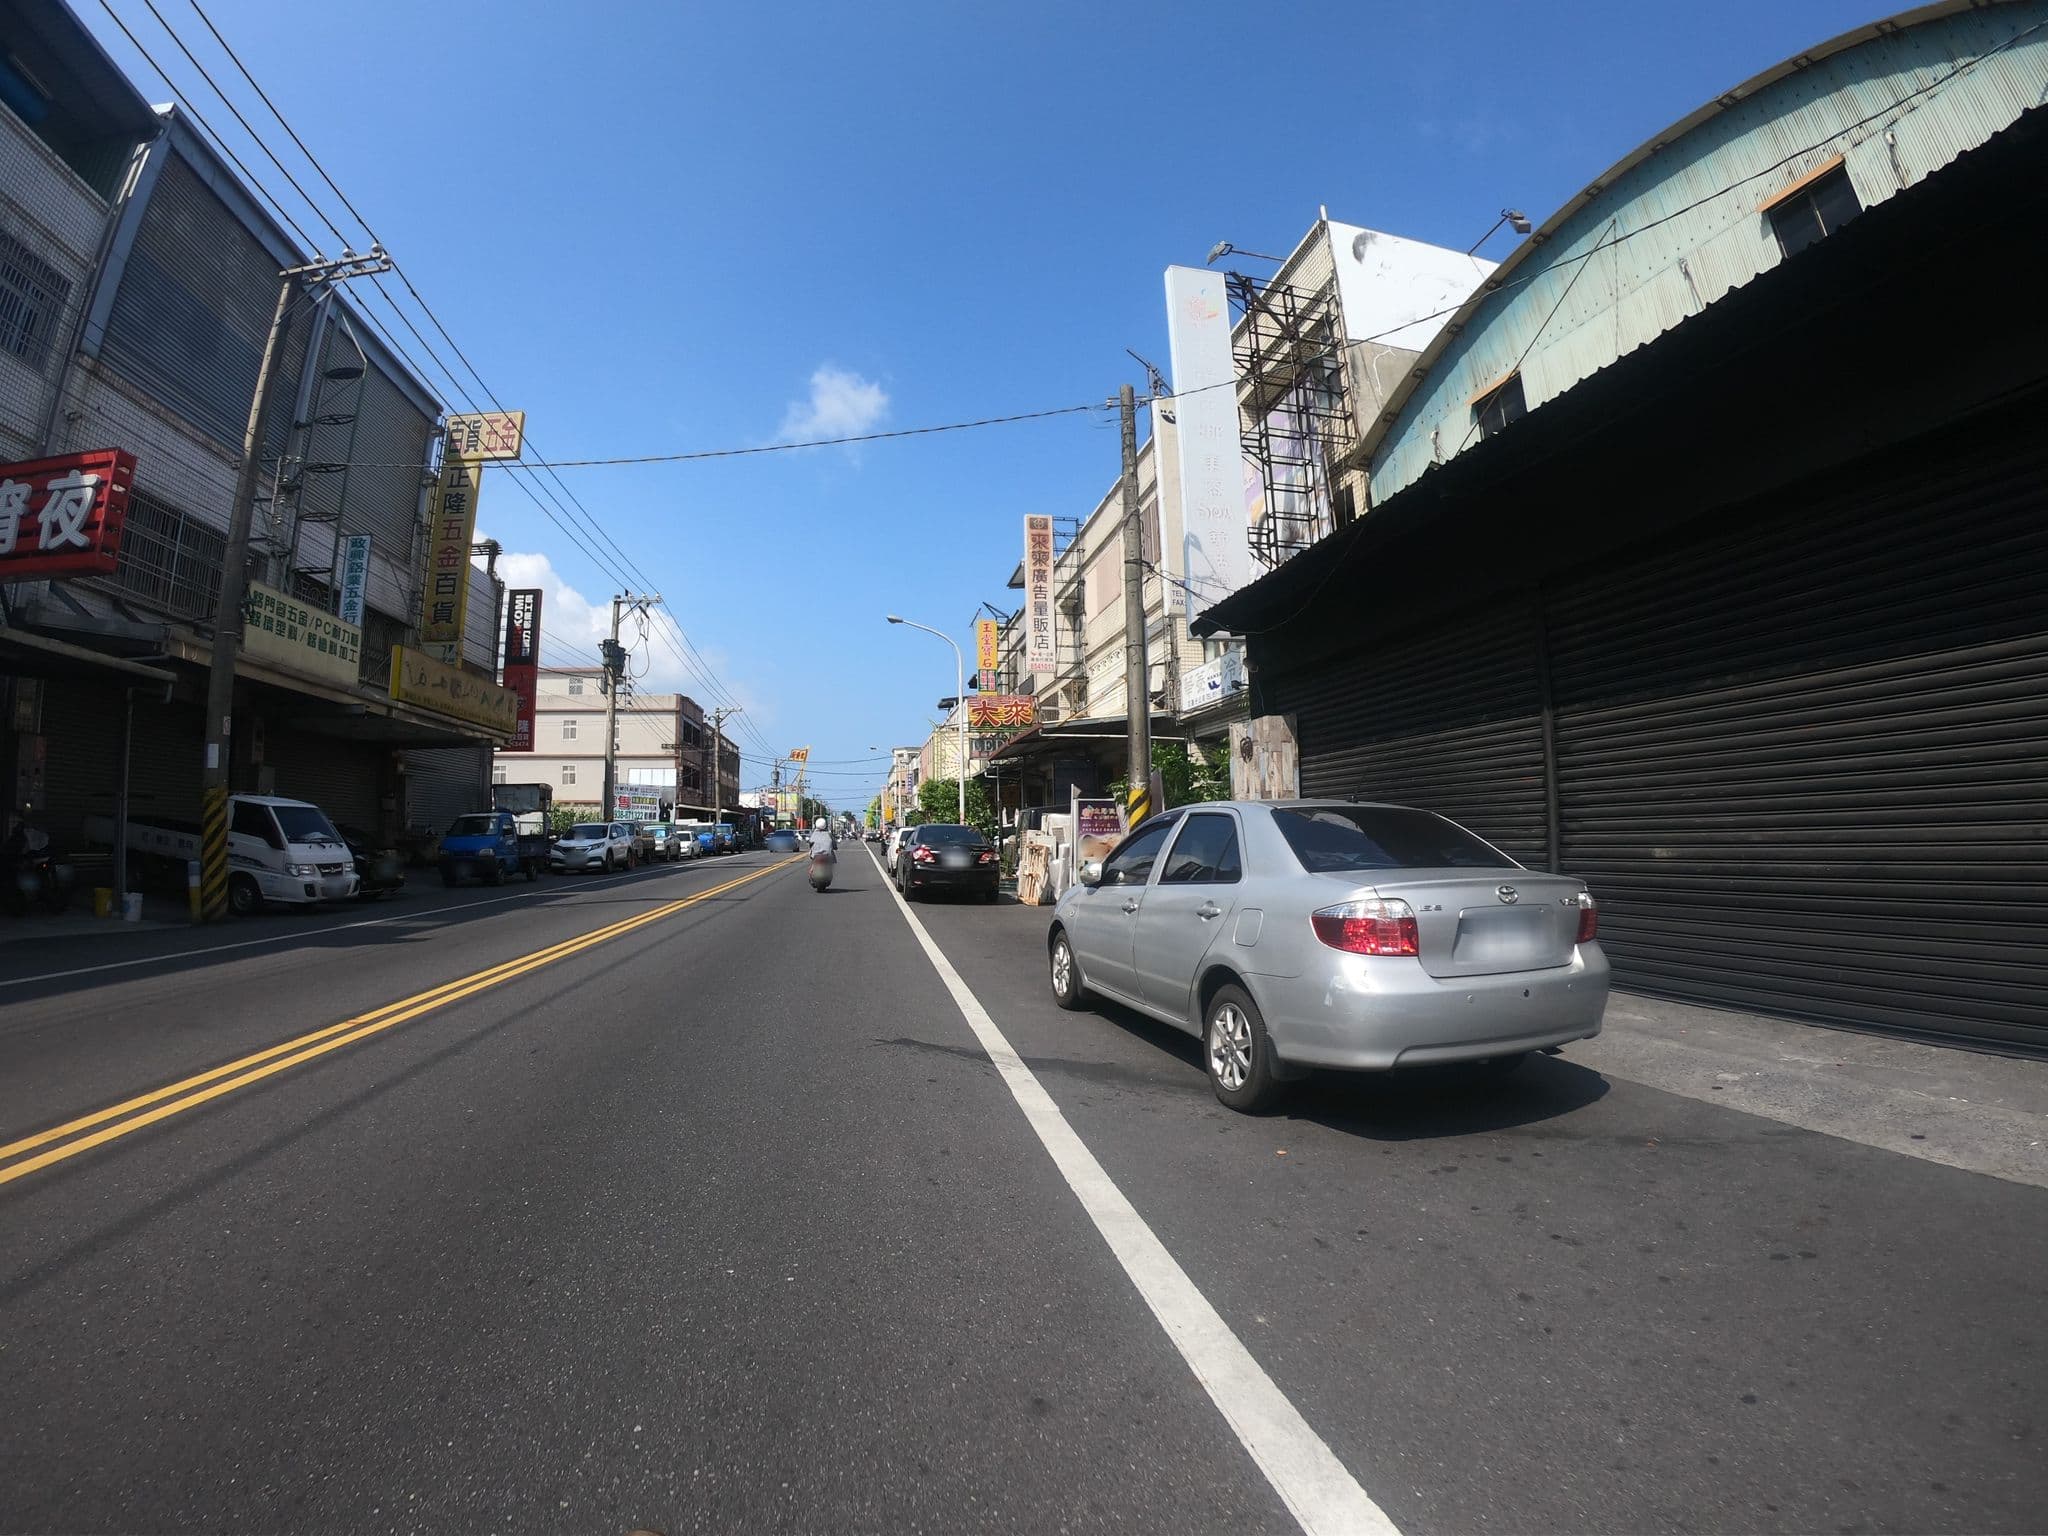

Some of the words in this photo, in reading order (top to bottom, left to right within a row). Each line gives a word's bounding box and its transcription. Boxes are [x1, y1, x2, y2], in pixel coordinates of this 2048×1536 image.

[0, 469, 102, 555] 宵夜
[430, 466, 470, 625] 正隆五金百貨
[971, 698, 1032, 727] 大來
